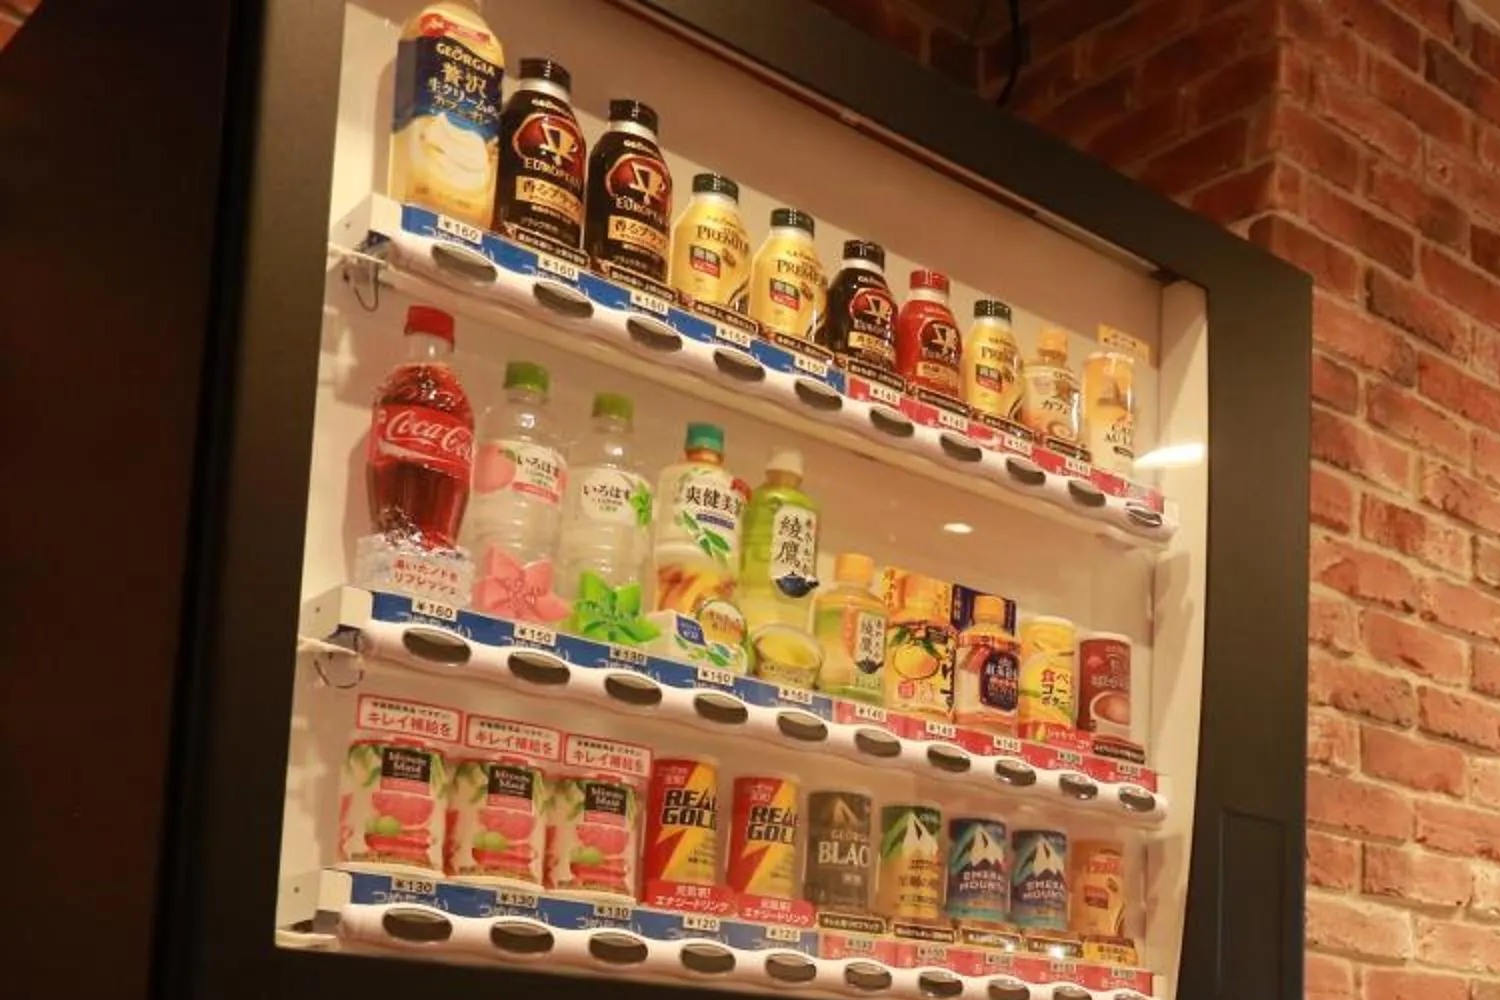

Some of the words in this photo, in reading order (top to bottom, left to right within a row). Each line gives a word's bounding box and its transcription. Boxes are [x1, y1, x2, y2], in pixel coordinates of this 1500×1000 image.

[436, 42, 496, 78] GEORGIA
[417, 602, 453, 620] ¥160
[519, 627, 551, 644] ¥150
[397, 877, 432, 893] ¥130
